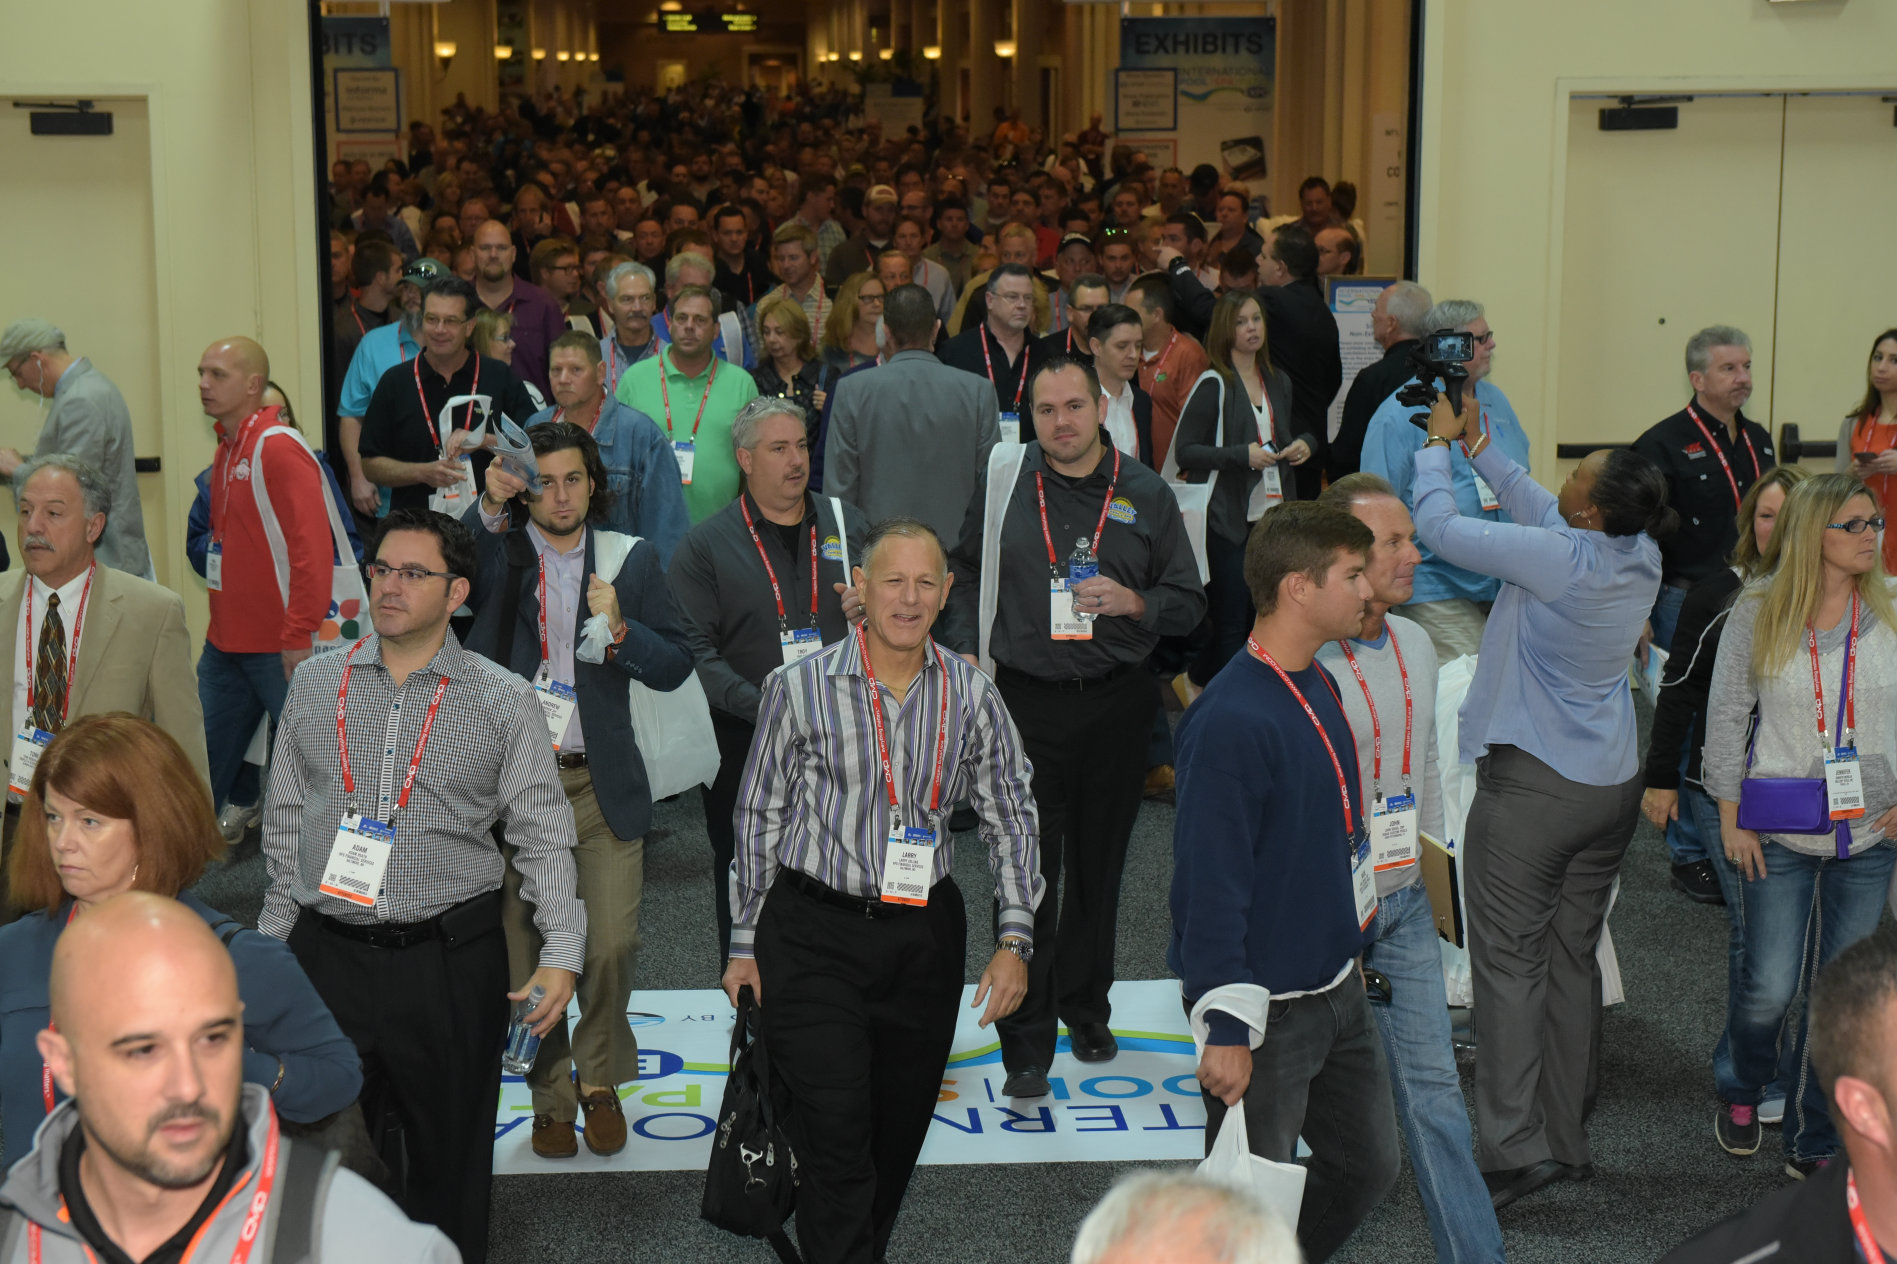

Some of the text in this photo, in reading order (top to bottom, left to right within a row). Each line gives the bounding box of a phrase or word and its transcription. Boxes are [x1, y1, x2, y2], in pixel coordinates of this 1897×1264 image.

[1135, 32, 1263, 54] EXHIBITS
[432, 684, 444, 705] CMP
[869, 677, 878, 700] CMP
[542, 700, 560, 710] ANDREW
[404, 765, 416, 788] CMP
[883, 760, 892, 783] CMP
[352, 844, 368, 853] ADAM
[681, 1014, 715, 1023] BY
[242, 1191, 266, 1241] CMP
